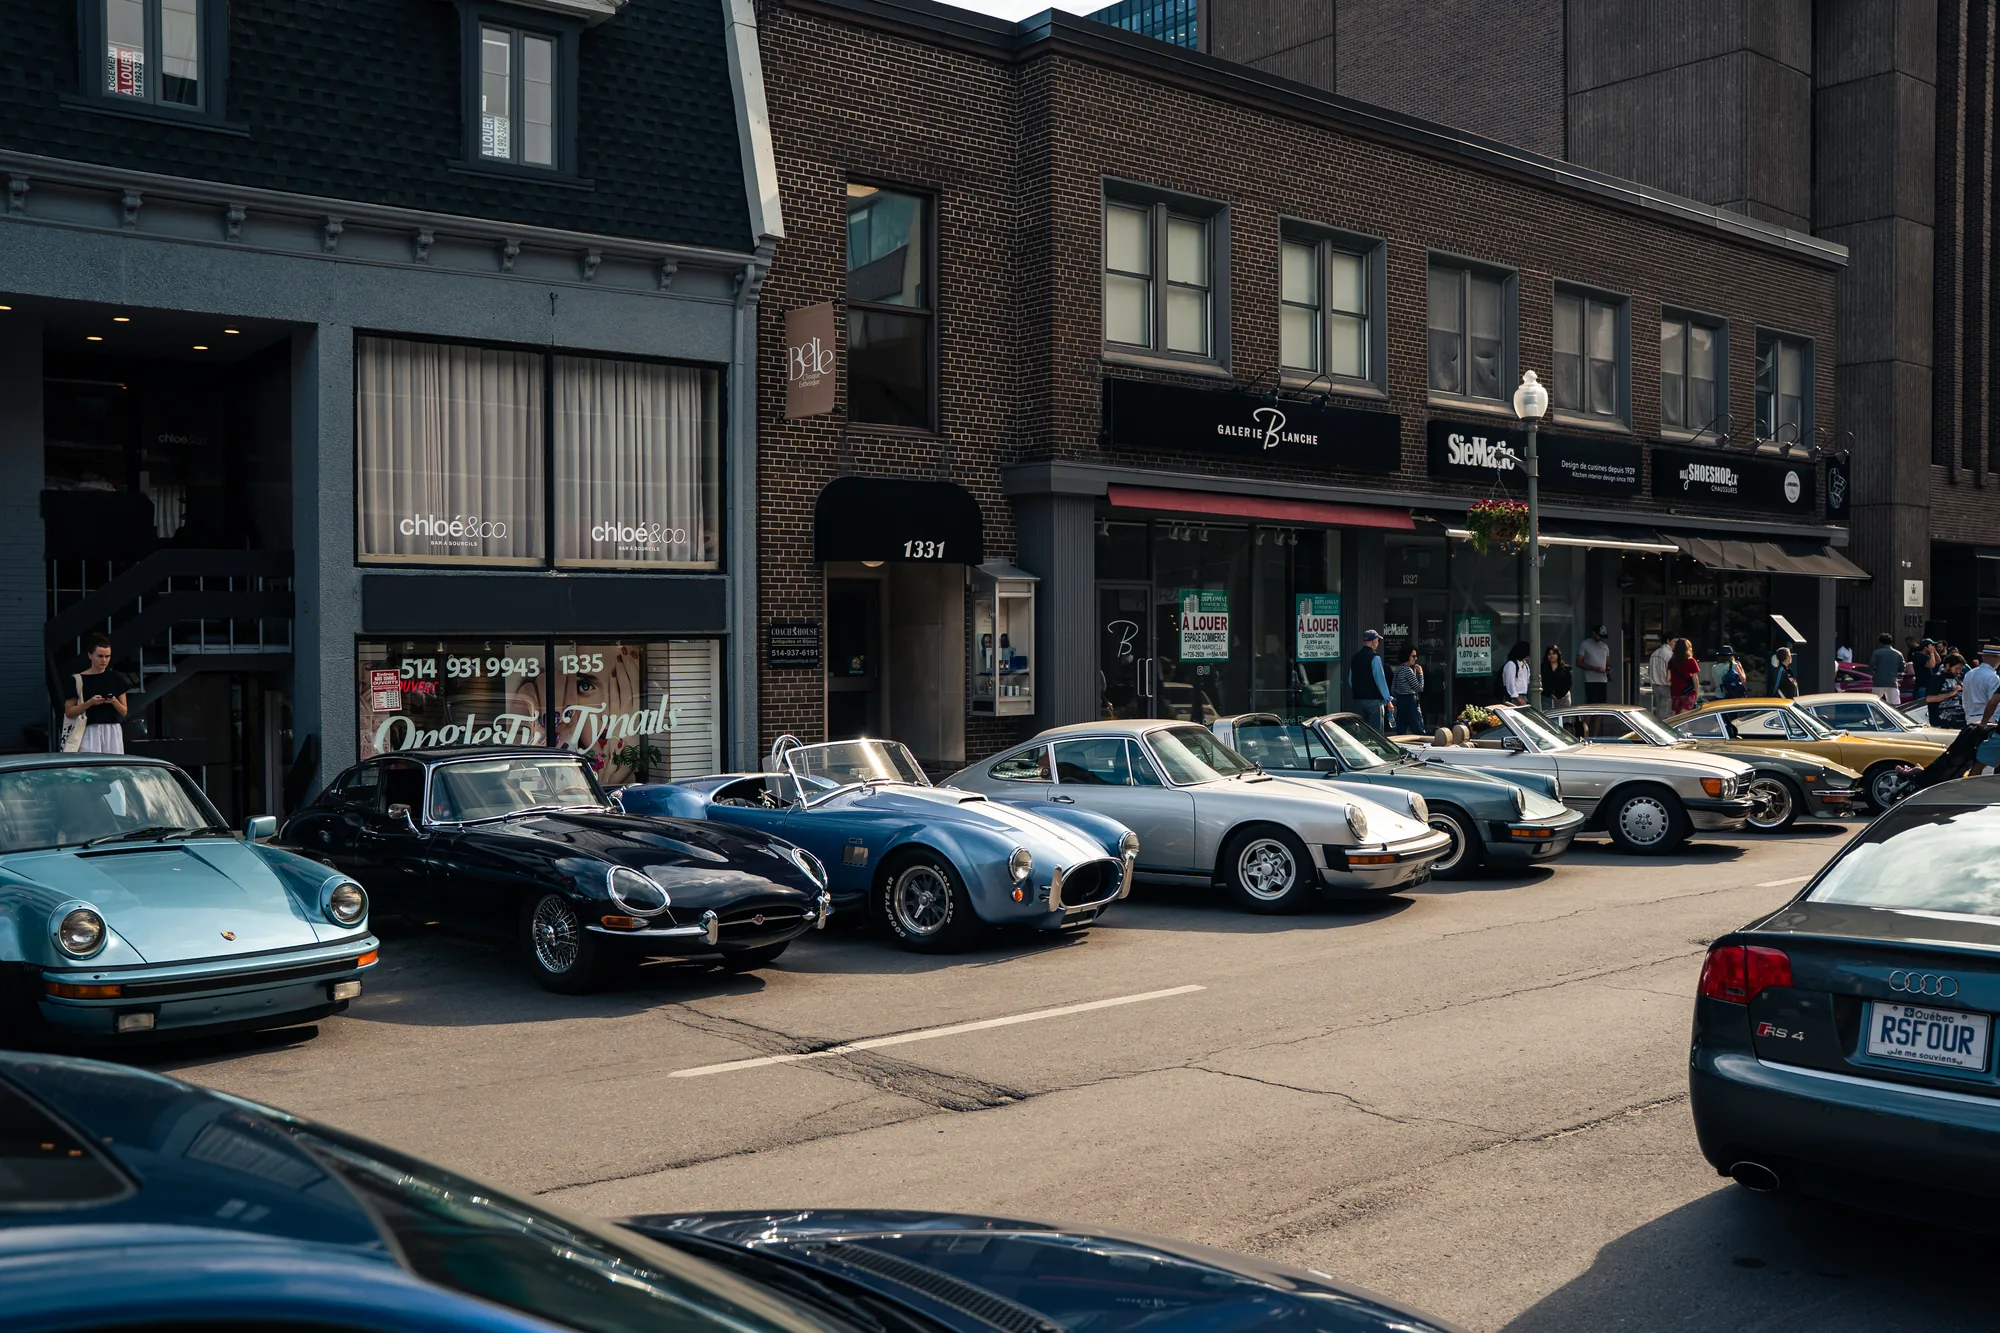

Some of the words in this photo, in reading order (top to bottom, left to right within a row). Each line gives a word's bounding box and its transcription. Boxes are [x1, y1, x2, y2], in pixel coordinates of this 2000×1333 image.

[120, 51, 132, 86] LOUER
[134, 84, 142, 97] 514
[482, 117, 494, 148] LOUER
[789, 336, 834, 381] Belle
[1218, 424, 1262, 438] GALERIE
[1448, 434, 1515, 470] SieMatic
[1562, 460, 1579, 470] Design
[1588, 464, 1607, 472] cuisines
[1608, 465, 1624, 474] depuis
[904, 540, 945, 558] 1331
[1402, 575, 1418, 584] 1327
[1182, 612, 1190, 630] À
[1193, 616, 1228, 630] LOUER
[1298, 615, 1304, 632] À
[1307, 618, 1338, 632] LOUER
[1108, 620, 1138, 658] B
[1184, 633, 1201, 642] ESPACE
[1202, 633, 1226, 642] COMMERCE
[1464, 636, 1490, 647] LOUER
[401, 658, 437, 679] 514
[446, 658, 481, 678] 931
[486, 657, 540, 677] 9943
[560, 654, 604, 674] 1335
[562, 694, 682, 754] Tynails
[934, 864, 953, 896] EAGLE
[884, 876, 906, 937] GOODYEAR
[1915, 1010, 1954, 1024] Québec
[1760, 1024, 1788, 1038] RS
[1791, 1032, 1804, 1041] 4
[1880, 1016, 1975, 1055] RSFOUR
[1919, 1052, 1956, 1063] souviens
